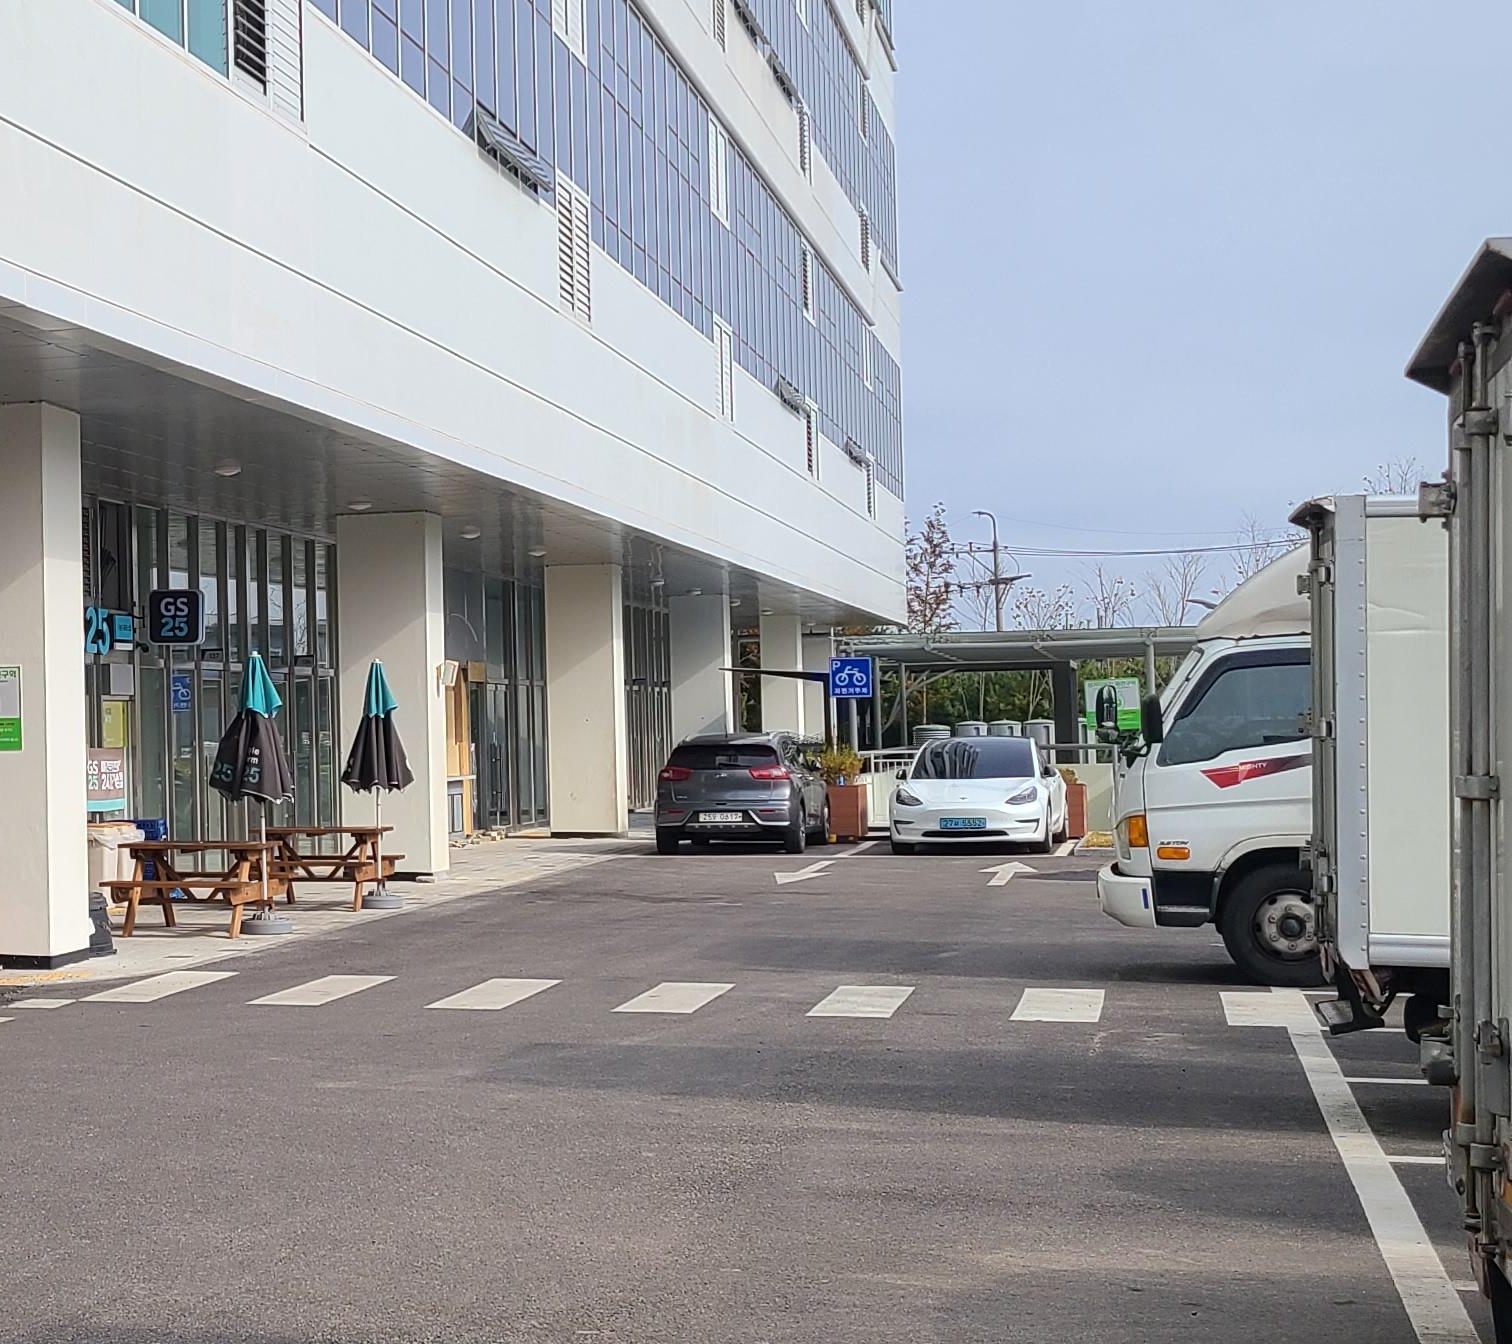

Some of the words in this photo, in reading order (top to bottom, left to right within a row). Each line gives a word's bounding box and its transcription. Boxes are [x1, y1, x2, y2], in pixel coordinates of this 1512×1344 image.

[160, 597, 189, 616] GS
[86, 607, 110, 655] 25
[160, 617, 189, 637] 25
[833, 661, 840, 670] P
[87, 760, 99, 775] GS
[88, 775, 99, 790] 25
